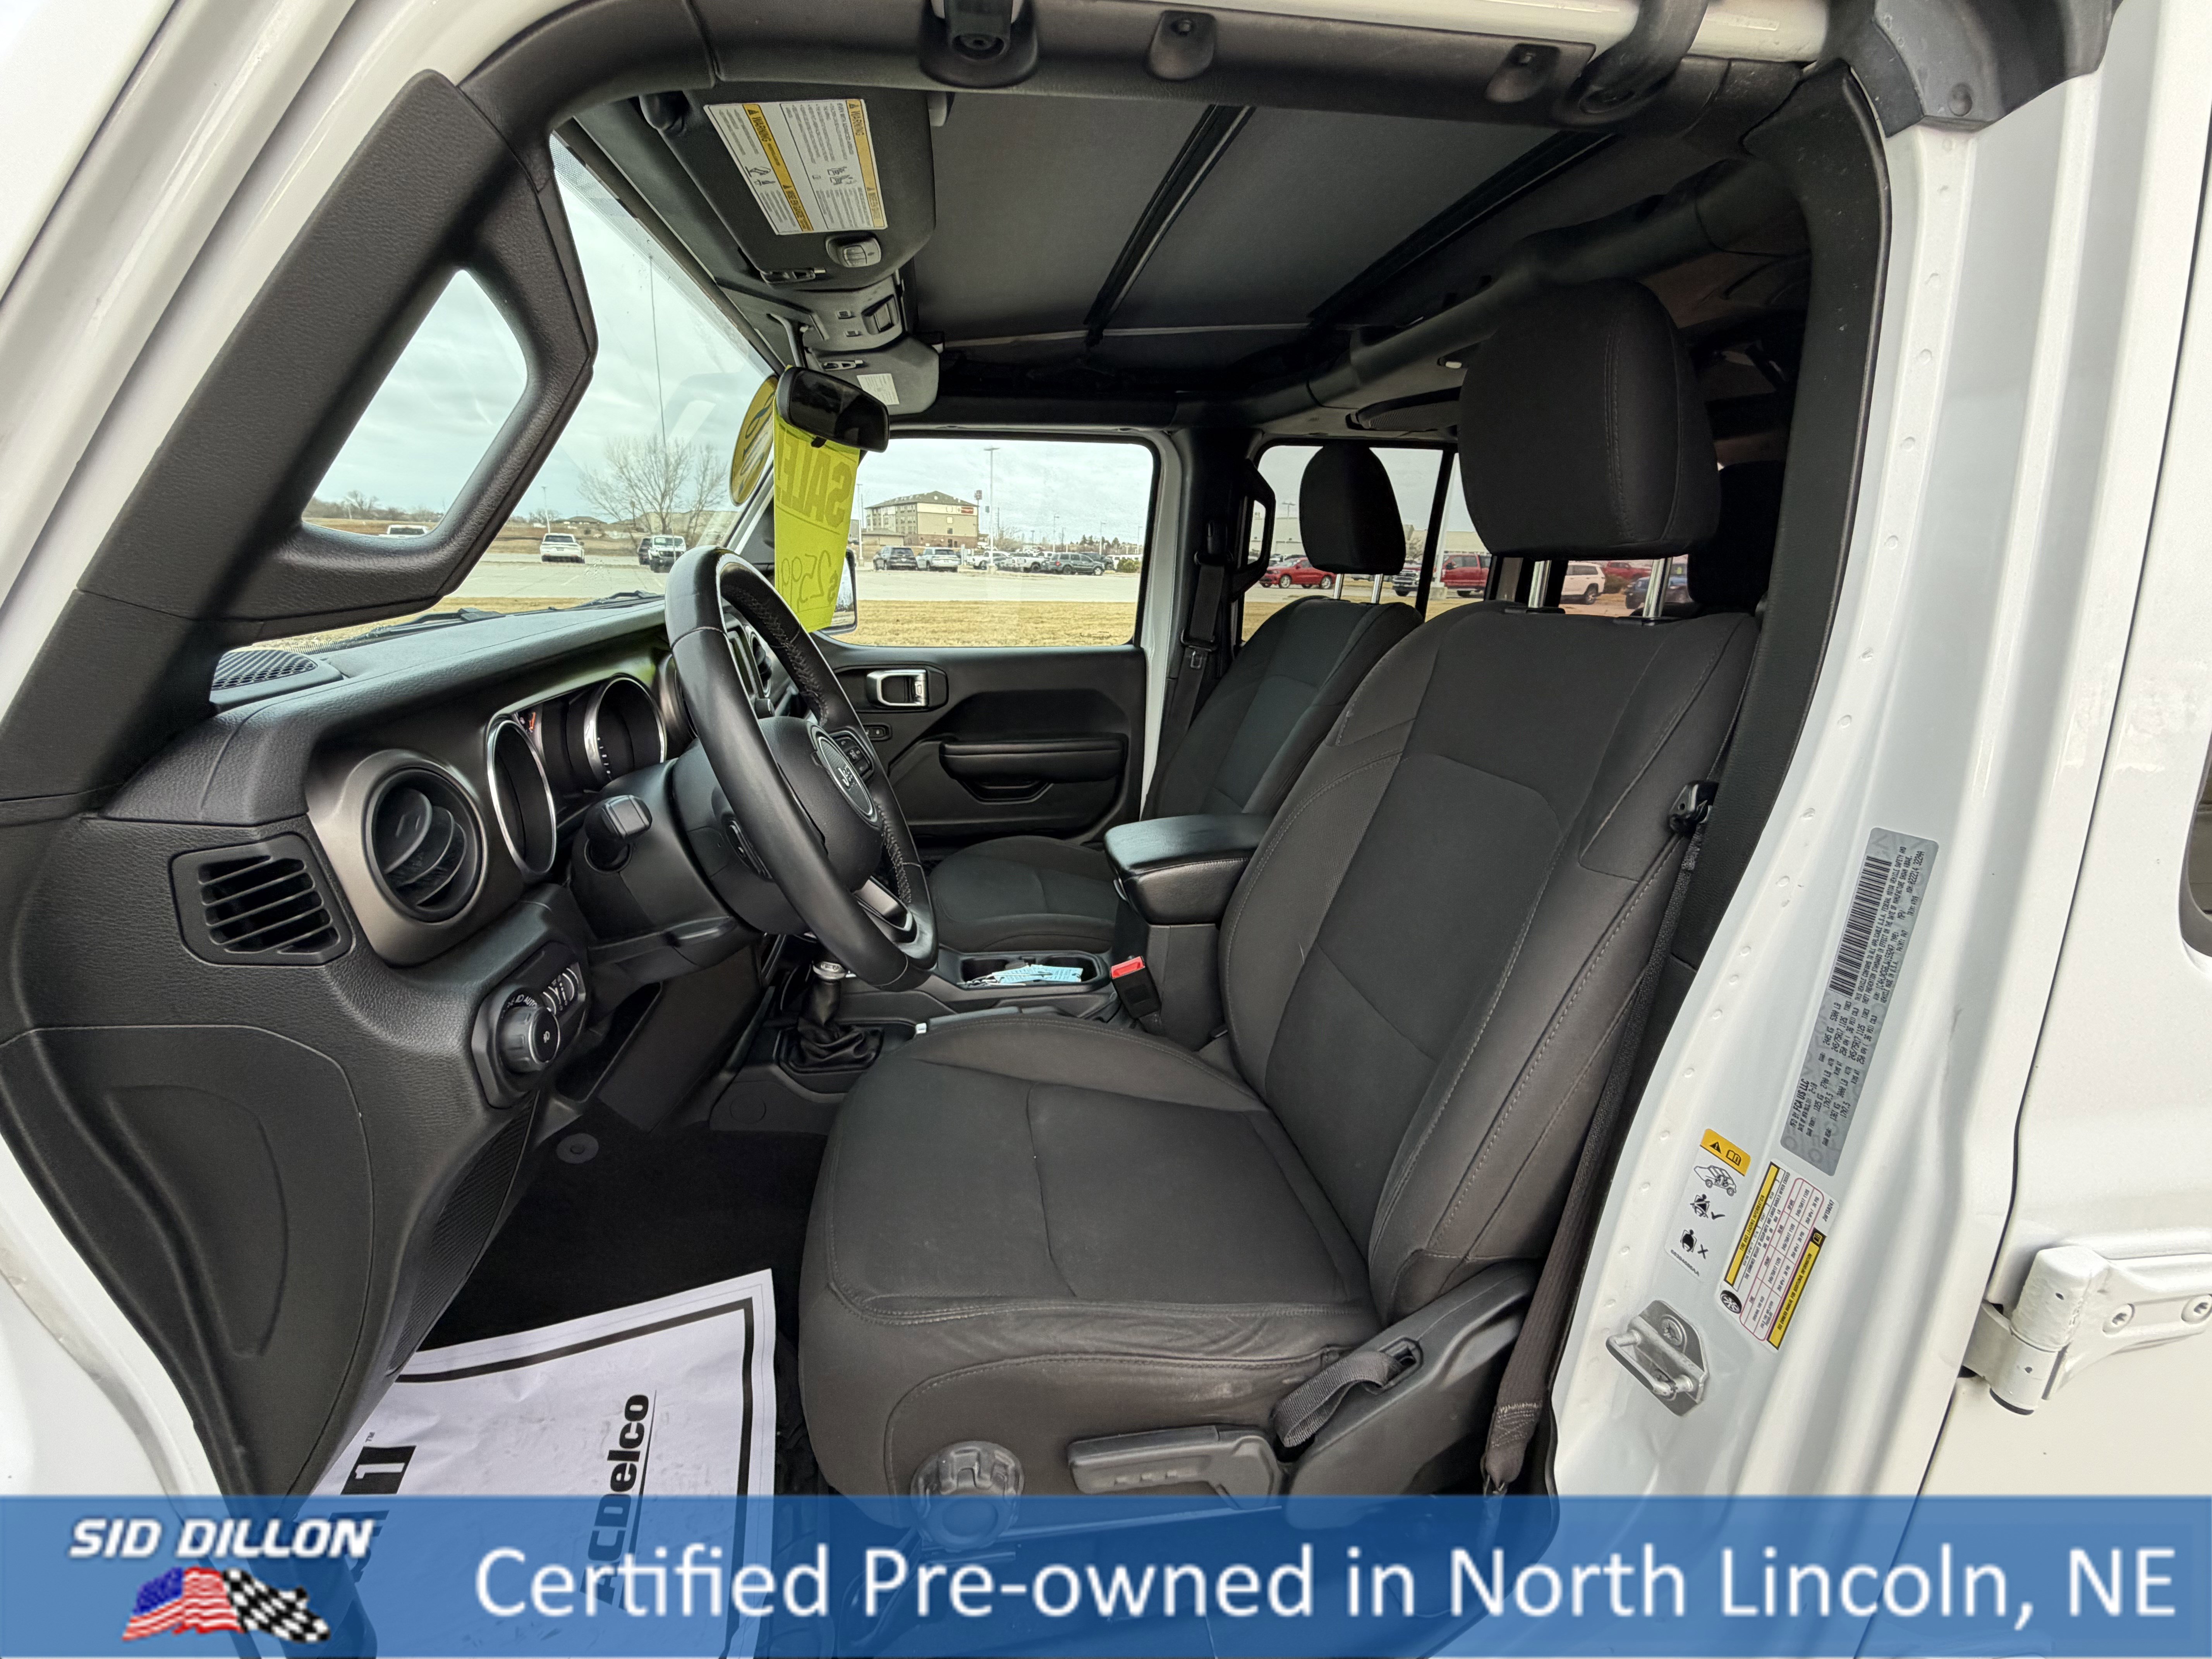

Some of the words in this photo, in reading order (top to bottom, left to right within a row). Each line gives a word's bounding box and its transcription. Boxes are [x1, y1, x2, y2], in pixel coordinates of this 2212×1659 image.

[751, 117, 772, 142] WARNING
[850, 110, 865, 136] WARNING
[1894, 854, 1904, 868] SAFETY
[1889, 868, 1900, 884] VEHICLE
[1881, 896, 1891, 912] FEDERAL
[1896, 909, 1906, 920] MPV
[1870, 926, 1882, 947] APPLICABLE
[1856, 977, 1867, 993] VEHICLE
[1865, 972, 1877, 994] PREVENTION
[1879, 988, 1890, 1003] VEHICLE
[1843, 1000, 1852, 1012] TIRES
[1826, 1025, 1834, 1034] KG
[1833, 1001, 1841, 1010] LB
[1838, 1015, 1848, 1028] 112S
[1830, 1027, 1844, 1053] 245/75R17
[1832, 1101, 1841, 1110] KG
[1839, 1077, 1849, 1087] LB
[1847, 1035, 1862, 1061] 245/75R17
[1855, 1023, 1866, 1036] 112S
[1861, 1007, 1870, 1019] TIRES
[1822, 1091, 1833, 1109] 17X7.5
[1845, 1025, 1854, 1034] 36
[1823, 1069, 1831, 1078] LB
[1839, 1100, 1851, 1118] 17X7.5
[1863, 1033, 1872, 1042] 36
[1799, 1077, 1810, 1092] LLC
[1796, 1089, 1806, 1101] US
[1816, 1092, 1824, 1101] KG
[1793, 1098, 1803, 1113] FCA
[1813, 1099, 1822, 1112] 1225
[1791, 1111, 1800, 1120] BY
